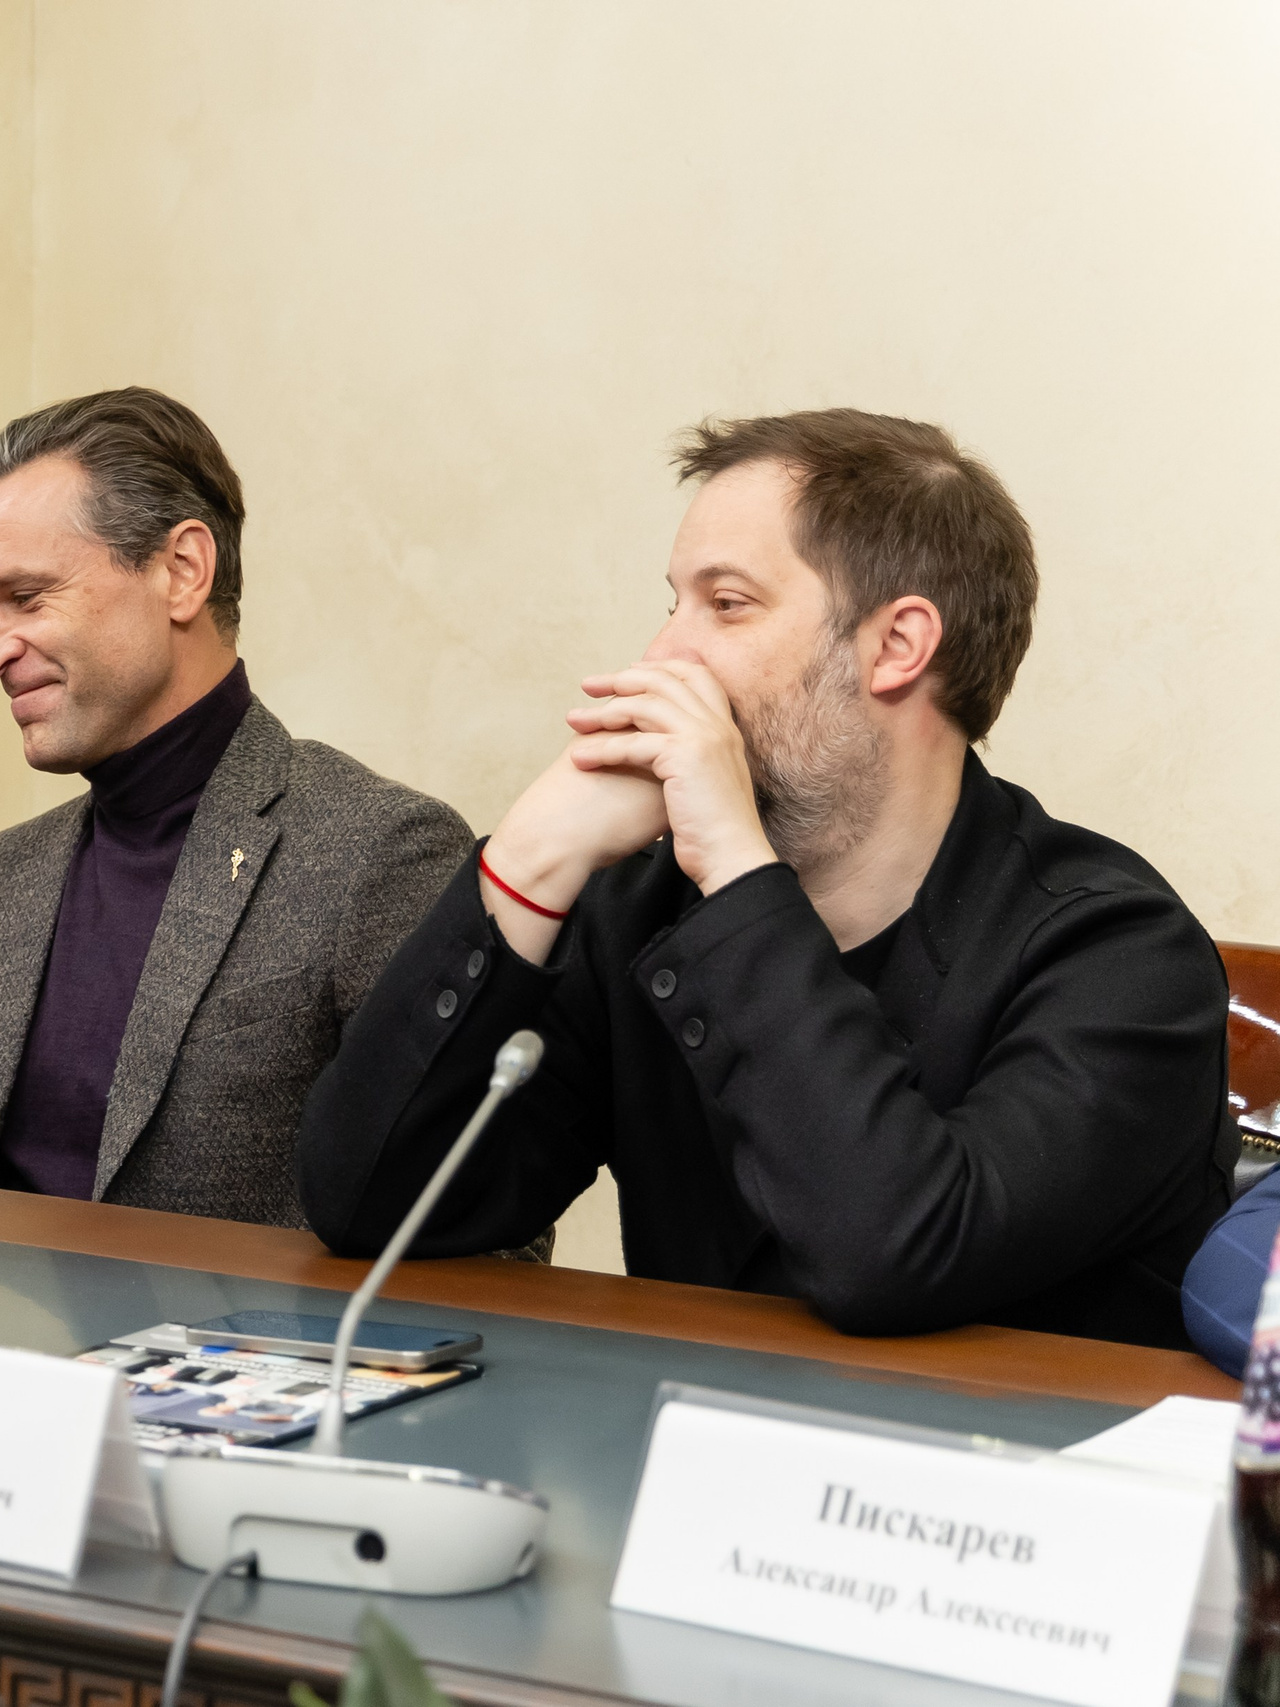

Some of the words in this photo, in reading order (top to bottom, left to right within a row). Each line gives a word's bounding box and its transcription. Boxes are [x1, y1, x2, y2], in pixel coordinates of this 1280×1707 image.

[817, 1482, 1037, 1564] Пискарев
[720, 1546, 898, 1613] Александр
[909, 1586, 1112, 1655] Алексеевич
